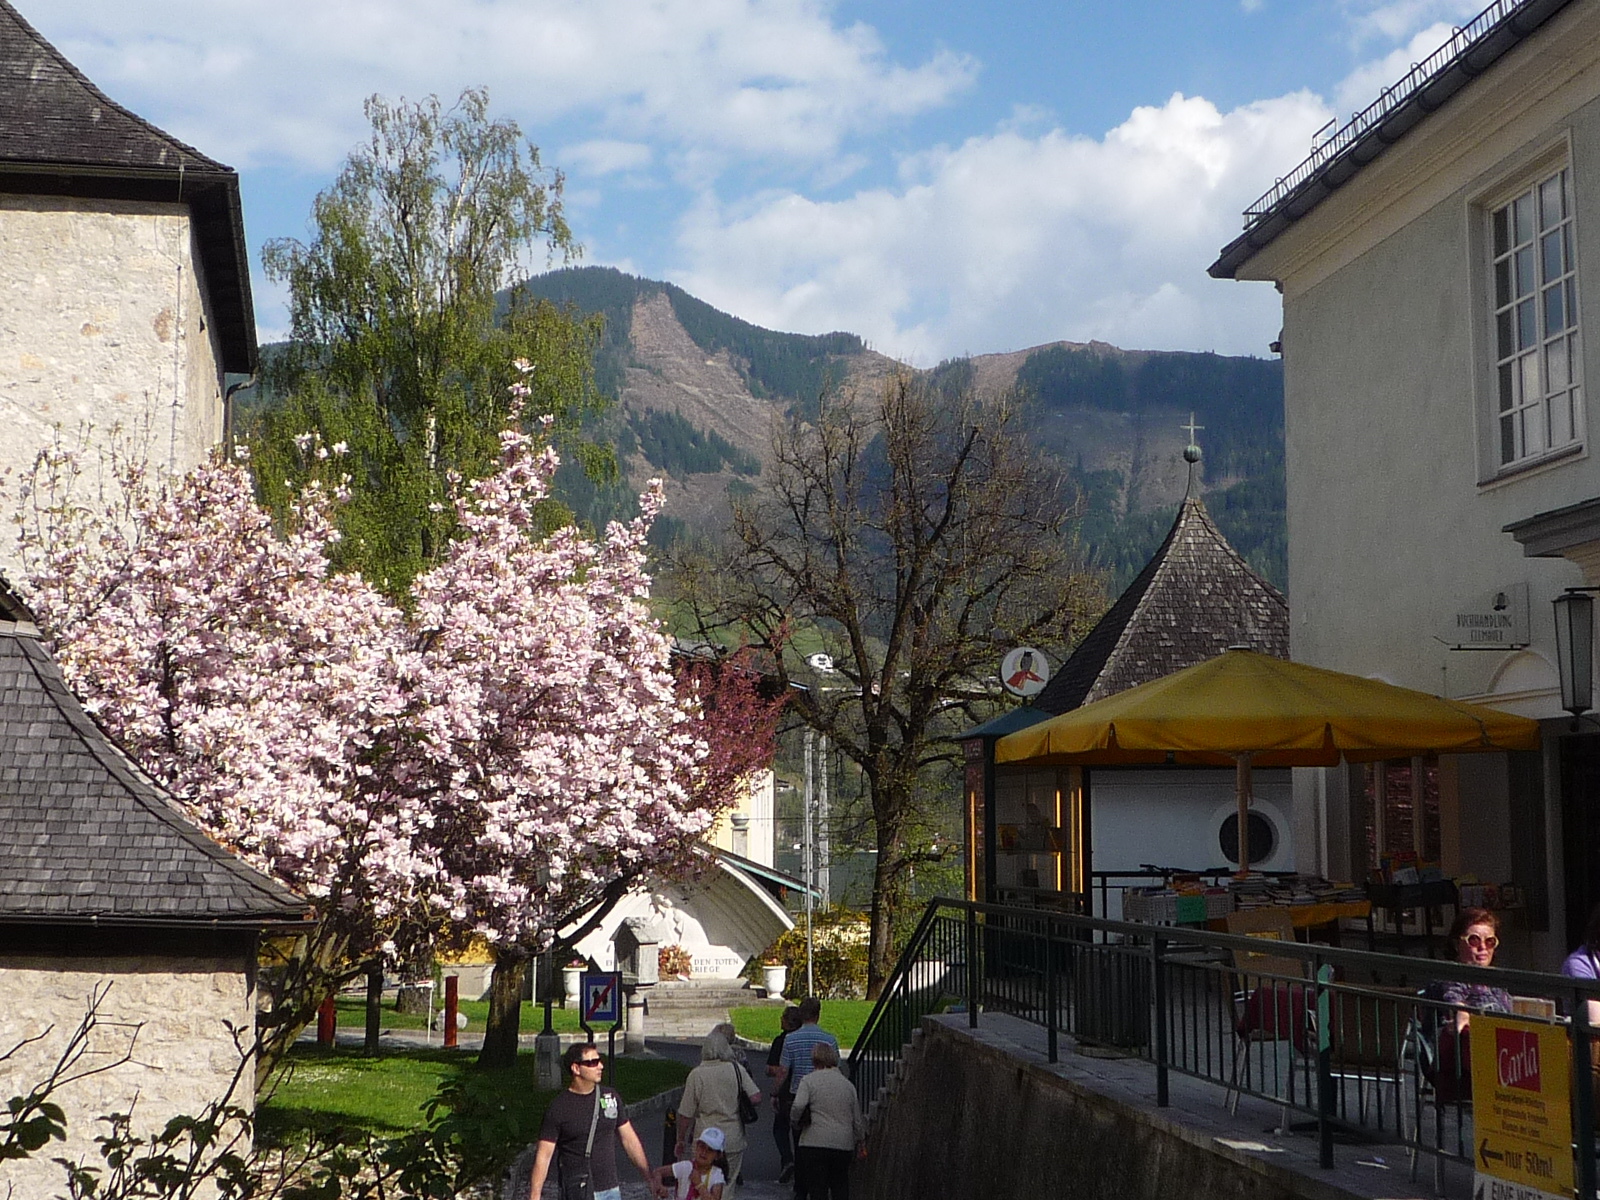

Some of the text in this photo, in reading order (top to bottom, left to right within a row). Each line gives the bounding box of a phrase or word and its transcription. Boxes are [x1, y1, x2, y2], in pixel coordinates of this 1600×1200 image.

[694, 958, 710, 966] DEN
[715, 958, 739, 966] TOTEN
[1498, 1031, 1538, 1088] Carla
[1504, 1149, 1553, 1179] nur 50m!
